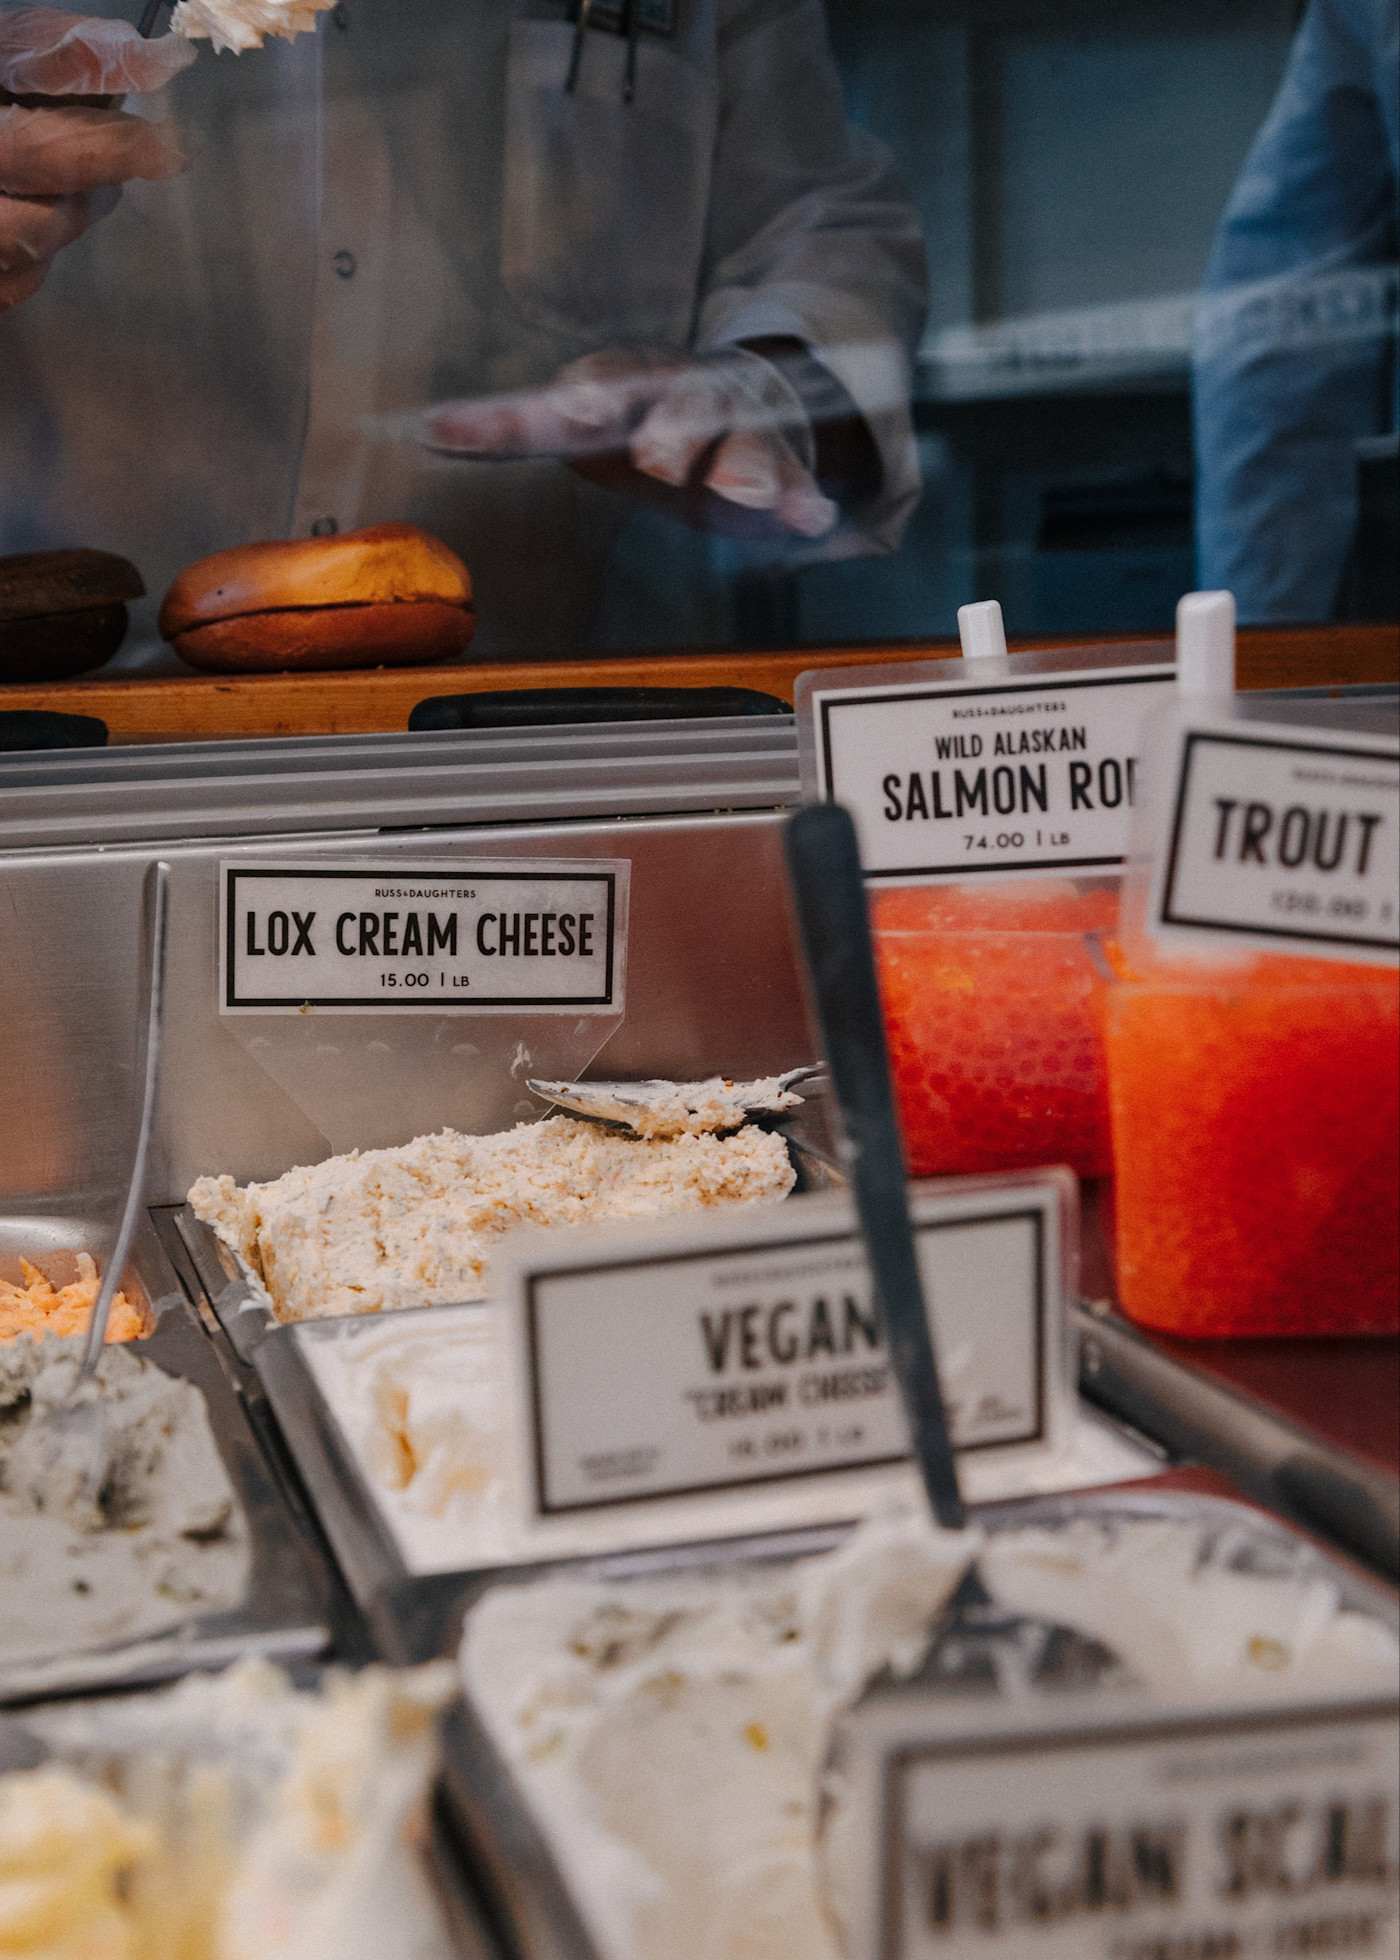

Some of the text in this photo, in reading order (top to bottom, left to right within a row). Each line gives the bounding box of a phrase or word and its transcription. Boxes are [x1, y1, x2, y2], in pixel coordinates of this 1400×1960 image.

[935, 725, 1087, 760] WILD ALASKAN
[882, 763, 1048, 822] SALMON
[963, 832, 1025, 850] 74.00
[1051, 832, 1071, 846] LB
[1215, 797, 1384, 877] TROUT
[246, 911, 595, 956] LOX CREAM CHEESE
[380, 973, 430, 988] 15.00
[453, 976, 470, 988] LB
[699, 1292, 880, 1376] VEGAN
